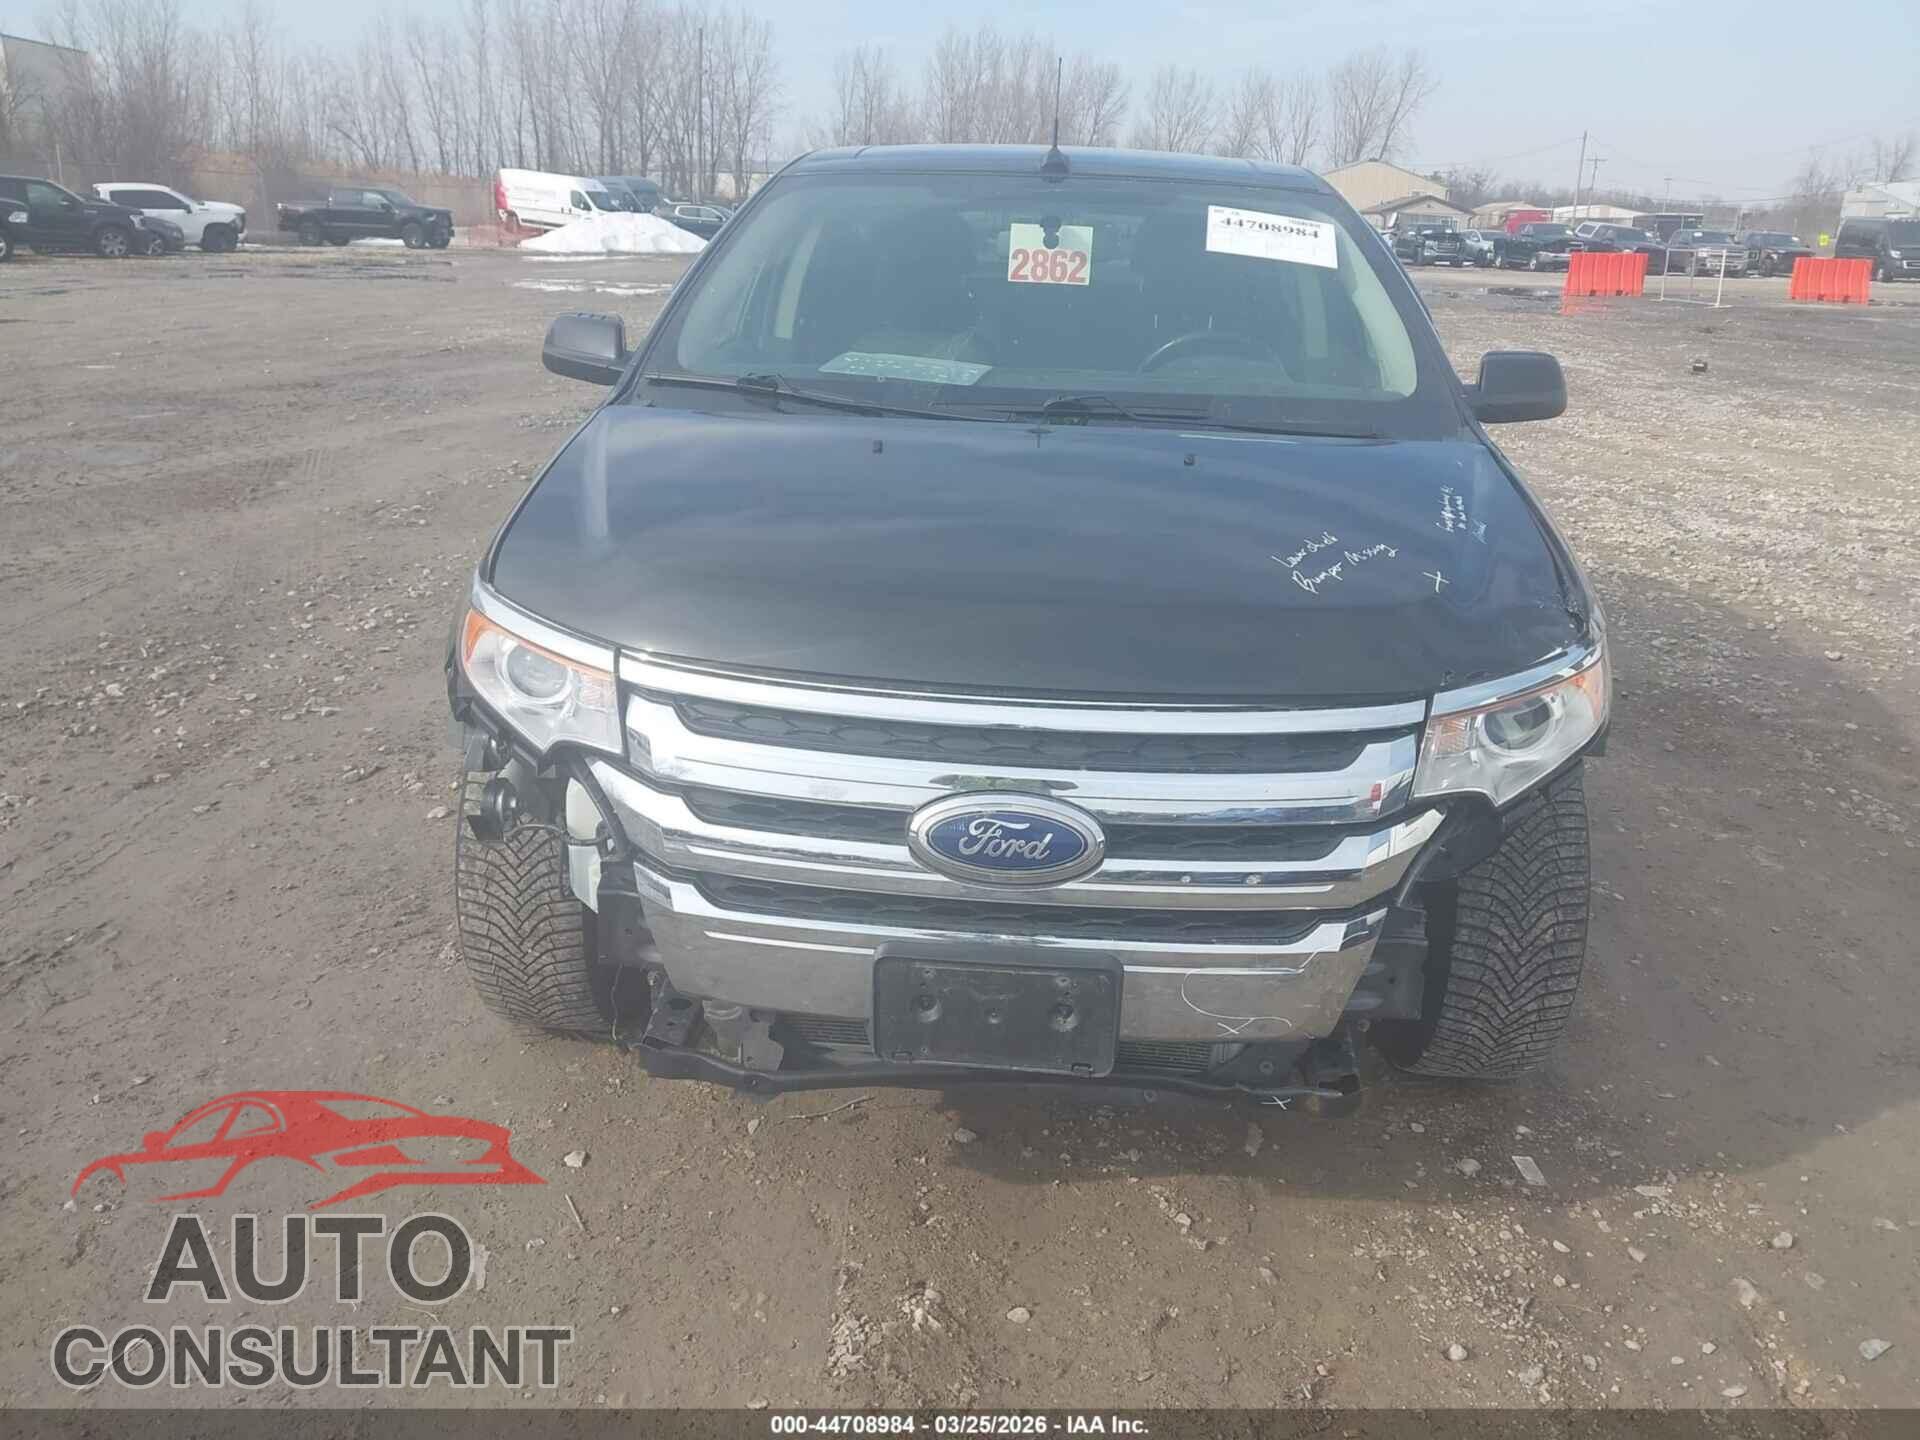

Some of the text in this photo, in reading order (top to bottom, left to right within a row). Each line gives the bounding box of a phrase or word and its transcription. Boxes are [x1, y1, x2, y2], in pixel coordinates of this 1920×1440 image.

[1219, 216, 1320, 240] 44708984
[1009, 248, 1089, 284] 2862
[958, 817, 1054, 860] Ford
